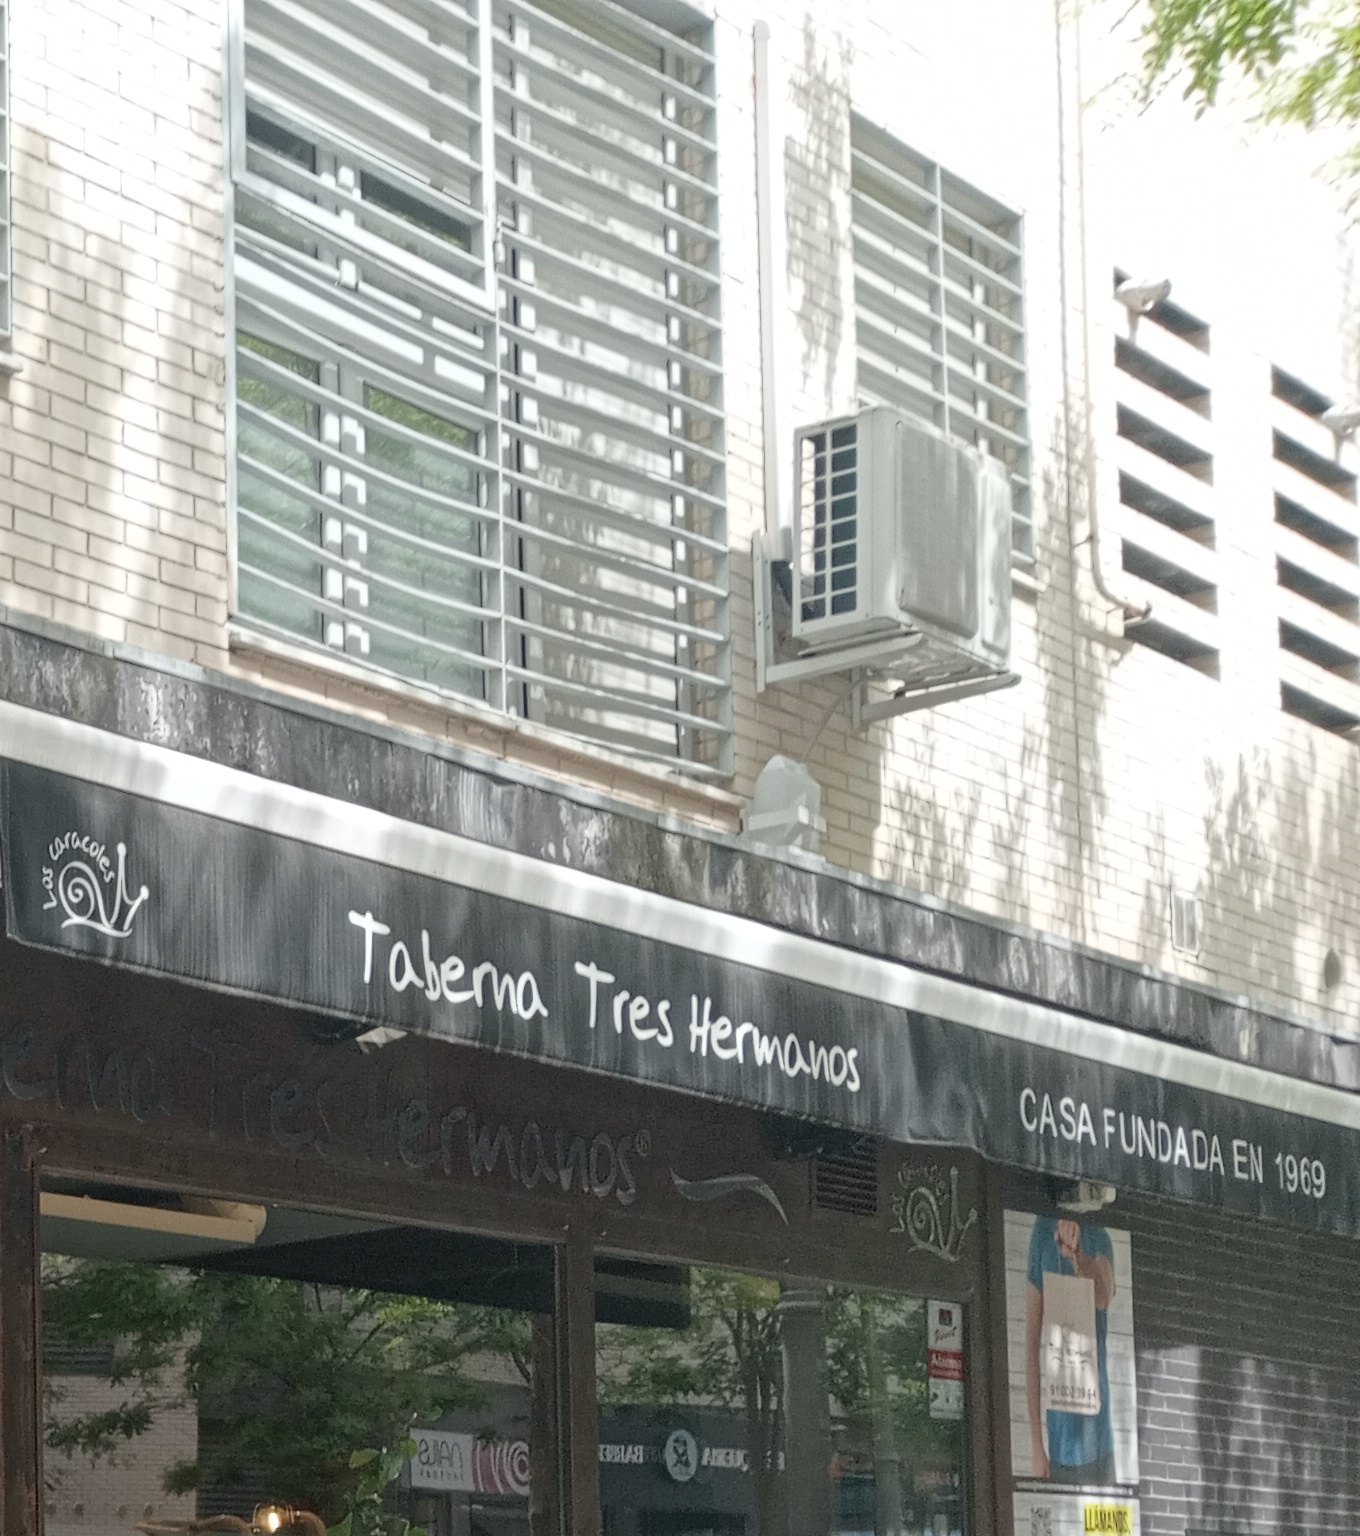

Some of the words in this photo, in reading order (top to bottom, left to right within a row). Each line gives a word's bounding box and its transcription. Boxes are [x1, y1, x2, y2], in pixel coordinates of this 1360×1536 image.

[41, 864, 59, 912] Los
[48, 831, 116, 884] caracoles
[346, 908, 550, 1022] Taberna
[573, 960, 676, 1050] Tres
[687, 992, 863, 1094] Hermanos
[1019, 1086, 1099, 1148] CASA
[1102, 1107, 1225, 1177] FUNDADA
[1232, 1139, 1265, 1185] EN
[1275, 1152, 1327, 1199] 1969
